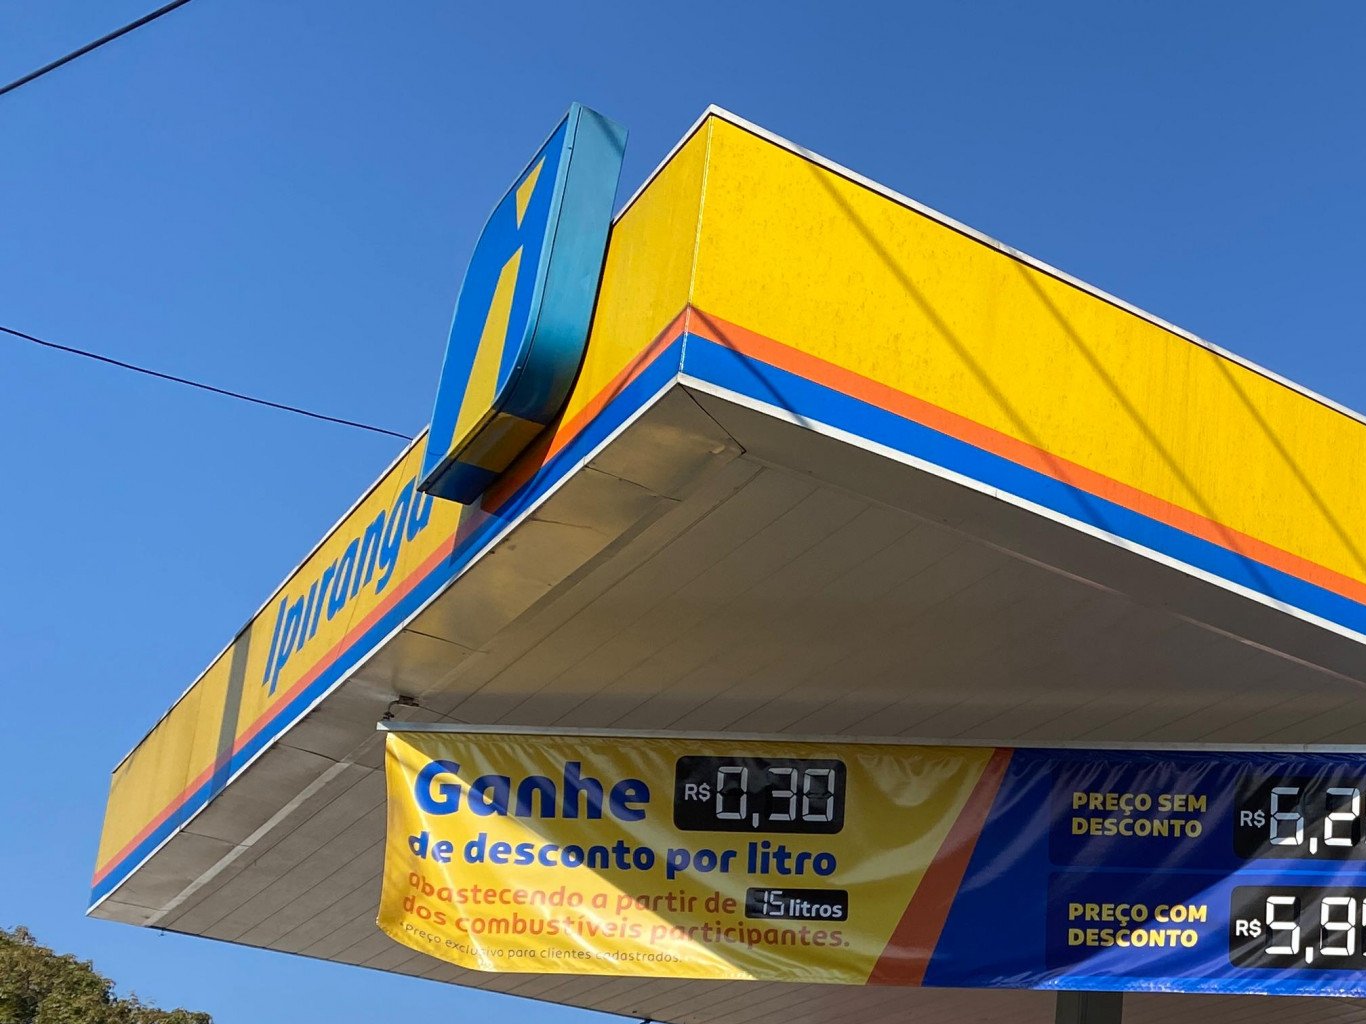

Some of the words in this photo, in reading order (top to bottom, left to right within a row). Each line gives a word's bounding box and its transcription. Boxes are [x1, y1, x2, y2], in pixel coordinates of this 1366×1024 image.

[261, 475, 434, 698] Ipiranga
[415, 759, 650, 821] Ganhe
[685, 782, 711, 802] R$
[716, 766, 835, 828] 0,30
[1072, 792, 1150, 817] PREÇO
[1157, 795, 1207, 813] SEM
[1071, 817, 1203, 838] DESCONTO
[1240, 810, 1266, 829] R$
[409, 831, 454, 862] de
[464, 831, 655, 871] desconto
[666, 848, 737, 879] por
[747, 841, 837, 876] litro
[409, 869, 584, 908] abastecendo
[591, 892, 607, 908] a
[616, 889, 697, 915] partir
[705, 892, 737, 914] de
[788, 892, 842, 918] litros
[403, 895, 447, 926] dos
[455, 911, 643, 940] combustíveis
[650, 917, 850, 949] participantes.
[1068, 903, 1148, 927] PREÇO
[1155, 904, 1207, 923] COM
[1068, 928, 1198, 948] DESCONTO
[1235, 919, 1262, 938] R$
[508, 948, 536, 961] para
[540, 947, 591, 960] clientes
